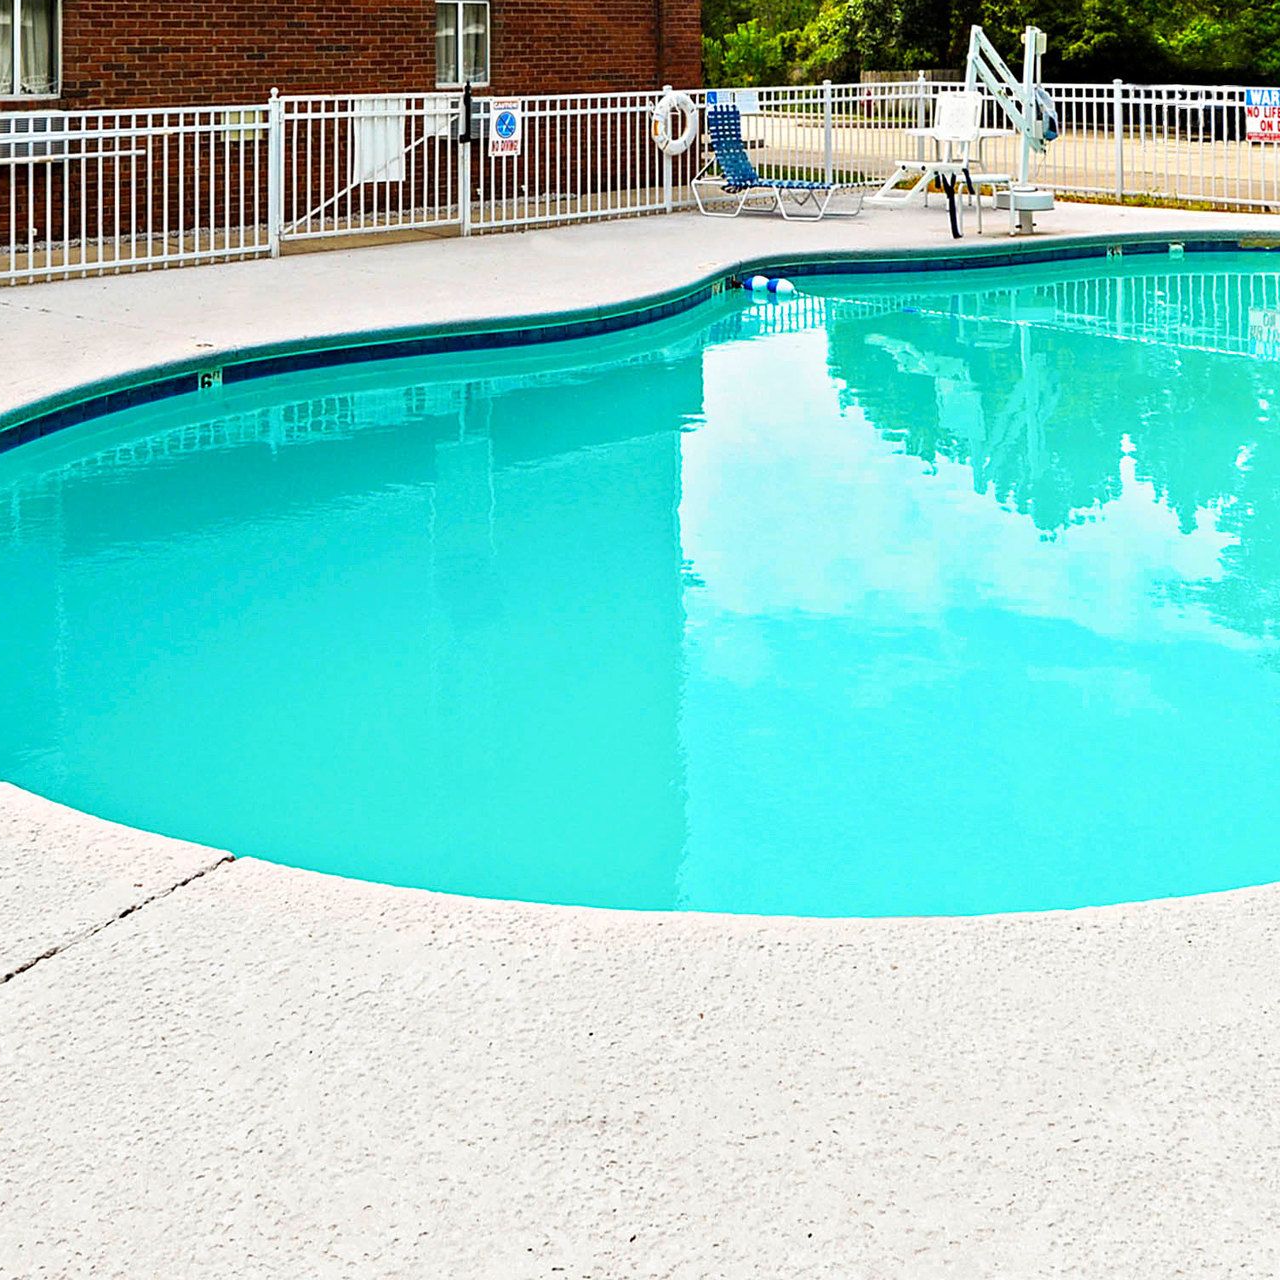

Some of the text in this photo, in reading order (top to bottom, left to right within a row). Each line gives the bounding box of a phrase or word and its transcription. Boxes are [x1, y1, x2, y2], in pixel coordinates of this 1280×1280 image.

[1247, 106, 1260, 118] NO
[1260, 119, 1273, 132] ON
[201, 373, 212, 389] 6
